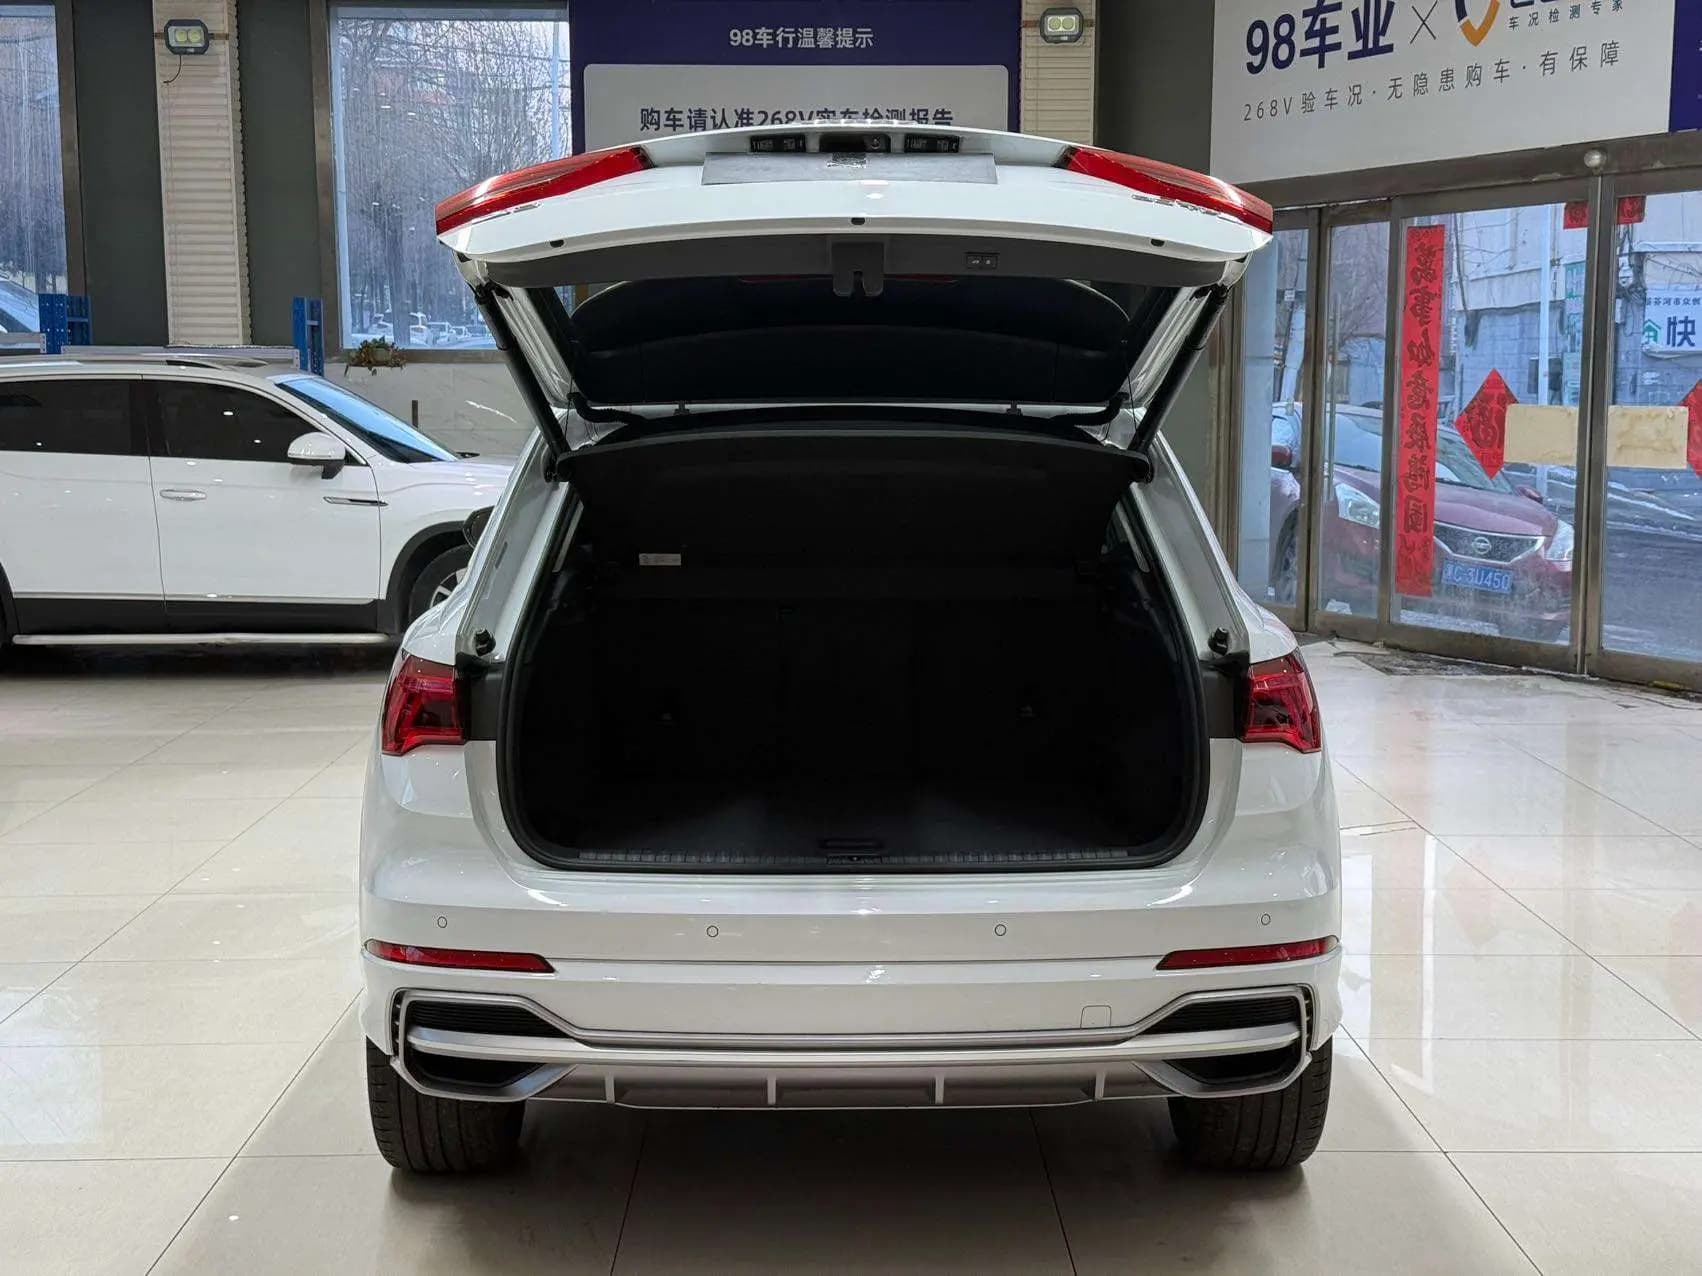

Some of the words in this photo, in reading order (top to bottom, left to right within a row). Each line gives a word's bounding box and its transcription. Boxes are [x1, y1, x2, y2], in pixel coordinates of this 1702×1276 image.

[1508, 0, 1624, 31] 车况检测专家
[729, 26, 875, 49] 98车行温馨提示
[1666, 316, 1696, 347] 快
